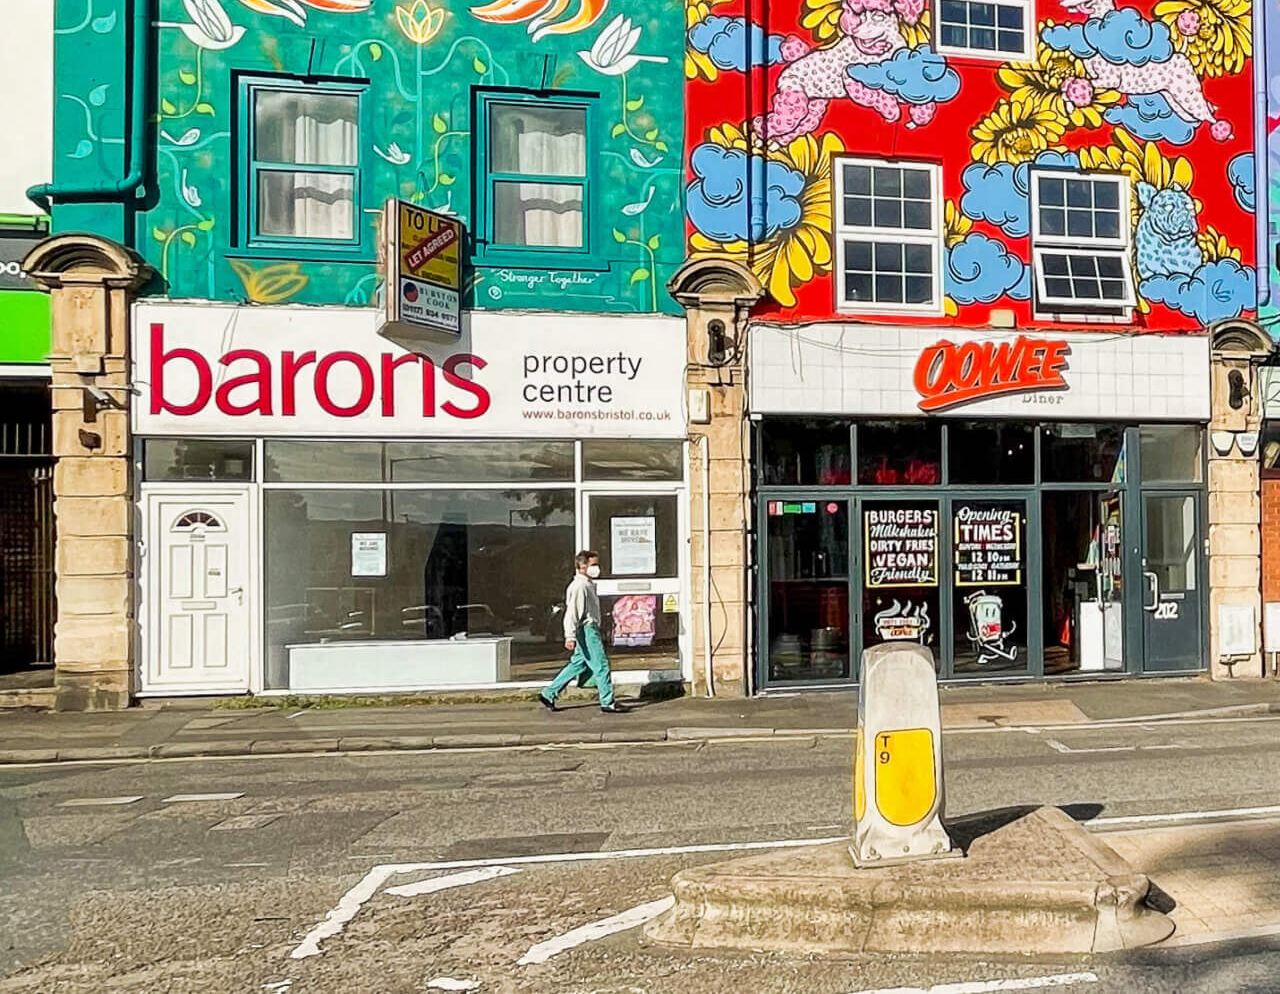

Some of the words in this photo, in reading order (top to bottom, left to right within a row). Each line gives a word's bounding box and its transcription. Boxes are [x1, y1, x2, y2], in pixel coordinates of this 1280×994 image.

[406, 208, 425, 231] TO
[408, 249, 424, 268] LET
[422, 229, 454, 257] AGREED
[149, 323, 491, 419] barons
[523, 351, 642, 380] property
[913, 334, 1073, 402] OOWEE
[522, 379, 613, 403] centre
[1022, 393, 1064, 405] Diner
[522, 409, 672, 421] www.baronsbristol.co.uk
[870, 509, 934, 524] BURGERS
[958, 506, 1014, 526] Opening
[960, 524, 1014, 542] TIMES
[870, 539, 902, 553] DIRTY
[905, 539, 934, 553] FRIES
[876, 553, 929, 567] VEGAN
[871, 566, 936, 585] Friendly
[1154, 601, 1179, 620] 202
[880, 734, 891, 749] T
[879, 750, 891, 765] 9
